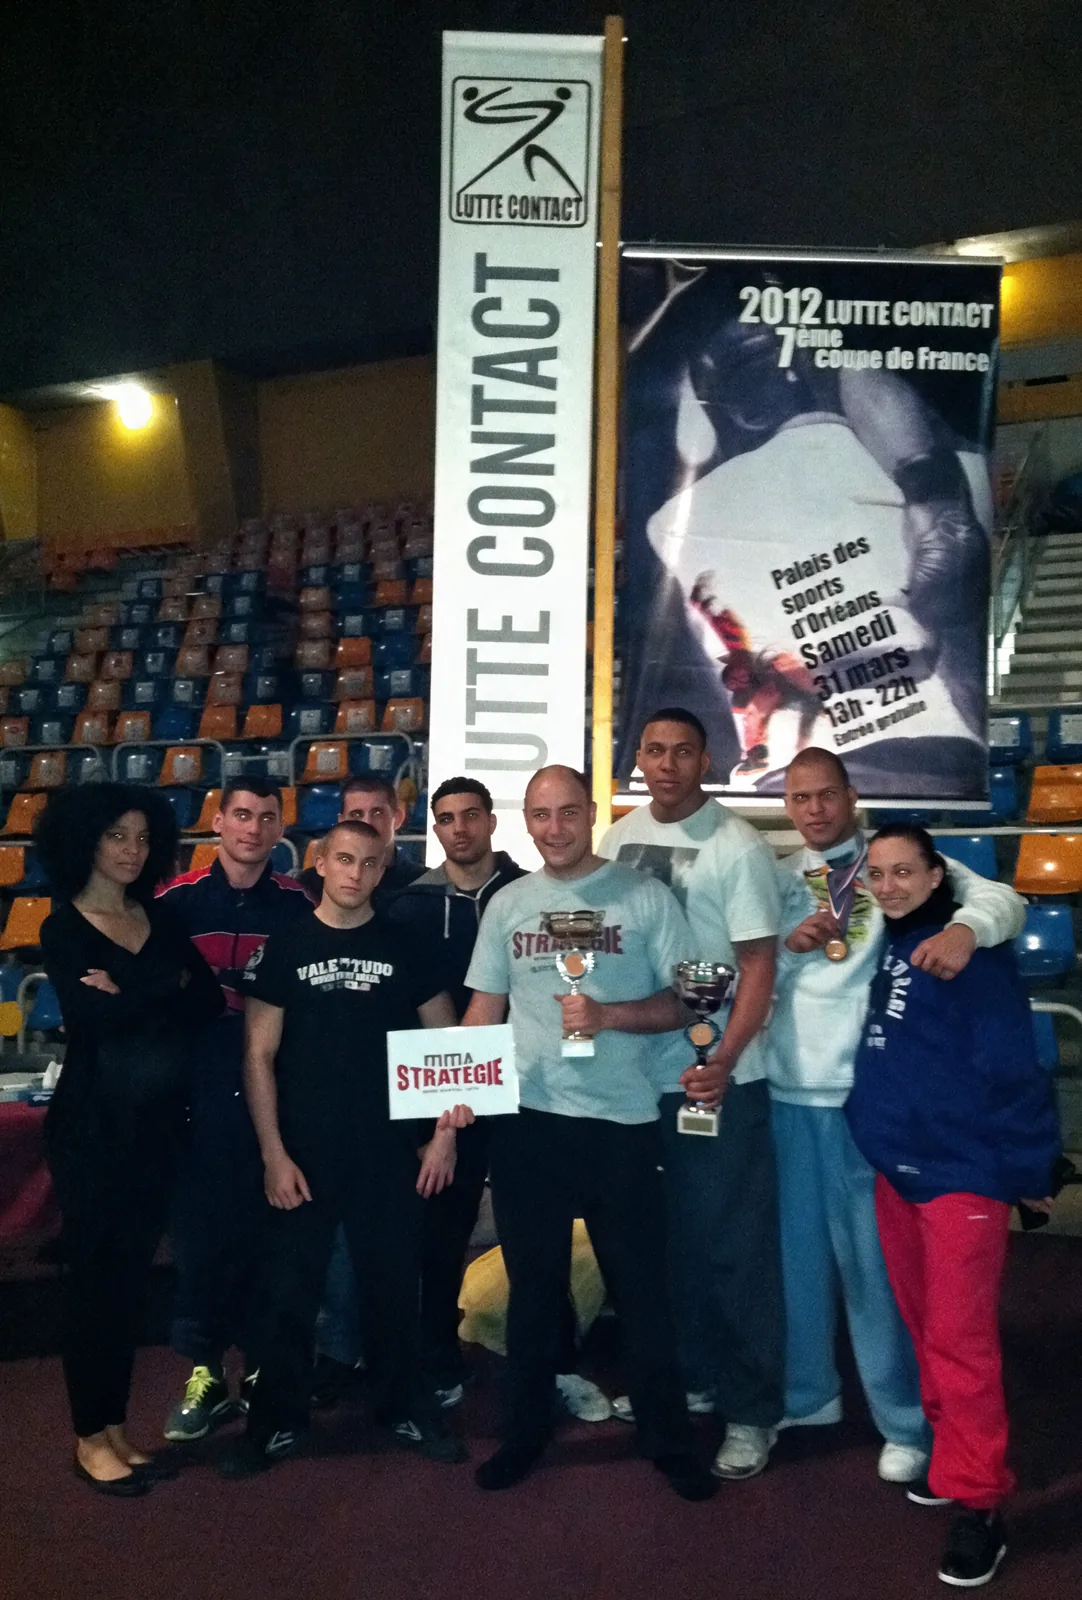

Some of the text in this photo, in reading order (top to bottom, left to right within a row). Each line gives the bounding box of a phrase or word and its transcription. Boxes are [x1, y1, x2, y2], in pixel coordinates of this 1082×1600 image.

[456, 191, 584, 222] LUTTE CONTACT
[738, 286, 994, 329] 2012 LUTTE CONTACT
[885, 346, 915, 371] de
[916, 346, 990, 373] France
[464, 252, 560, 772] UTTE CONTACT
[770, 536, 872, 591] Palais des
[781, 575, 845, 616] sports
[790, 589, 883, 640] d'Orléans
[800, 609, 898, 670] Samedi
[812, 646, 911, 702] 31 mars
[296, 958, 339, 981] VALE
[351, 958, 394, 977] TUDO
[396, 1057, 504, 1092] STRATEGIE
